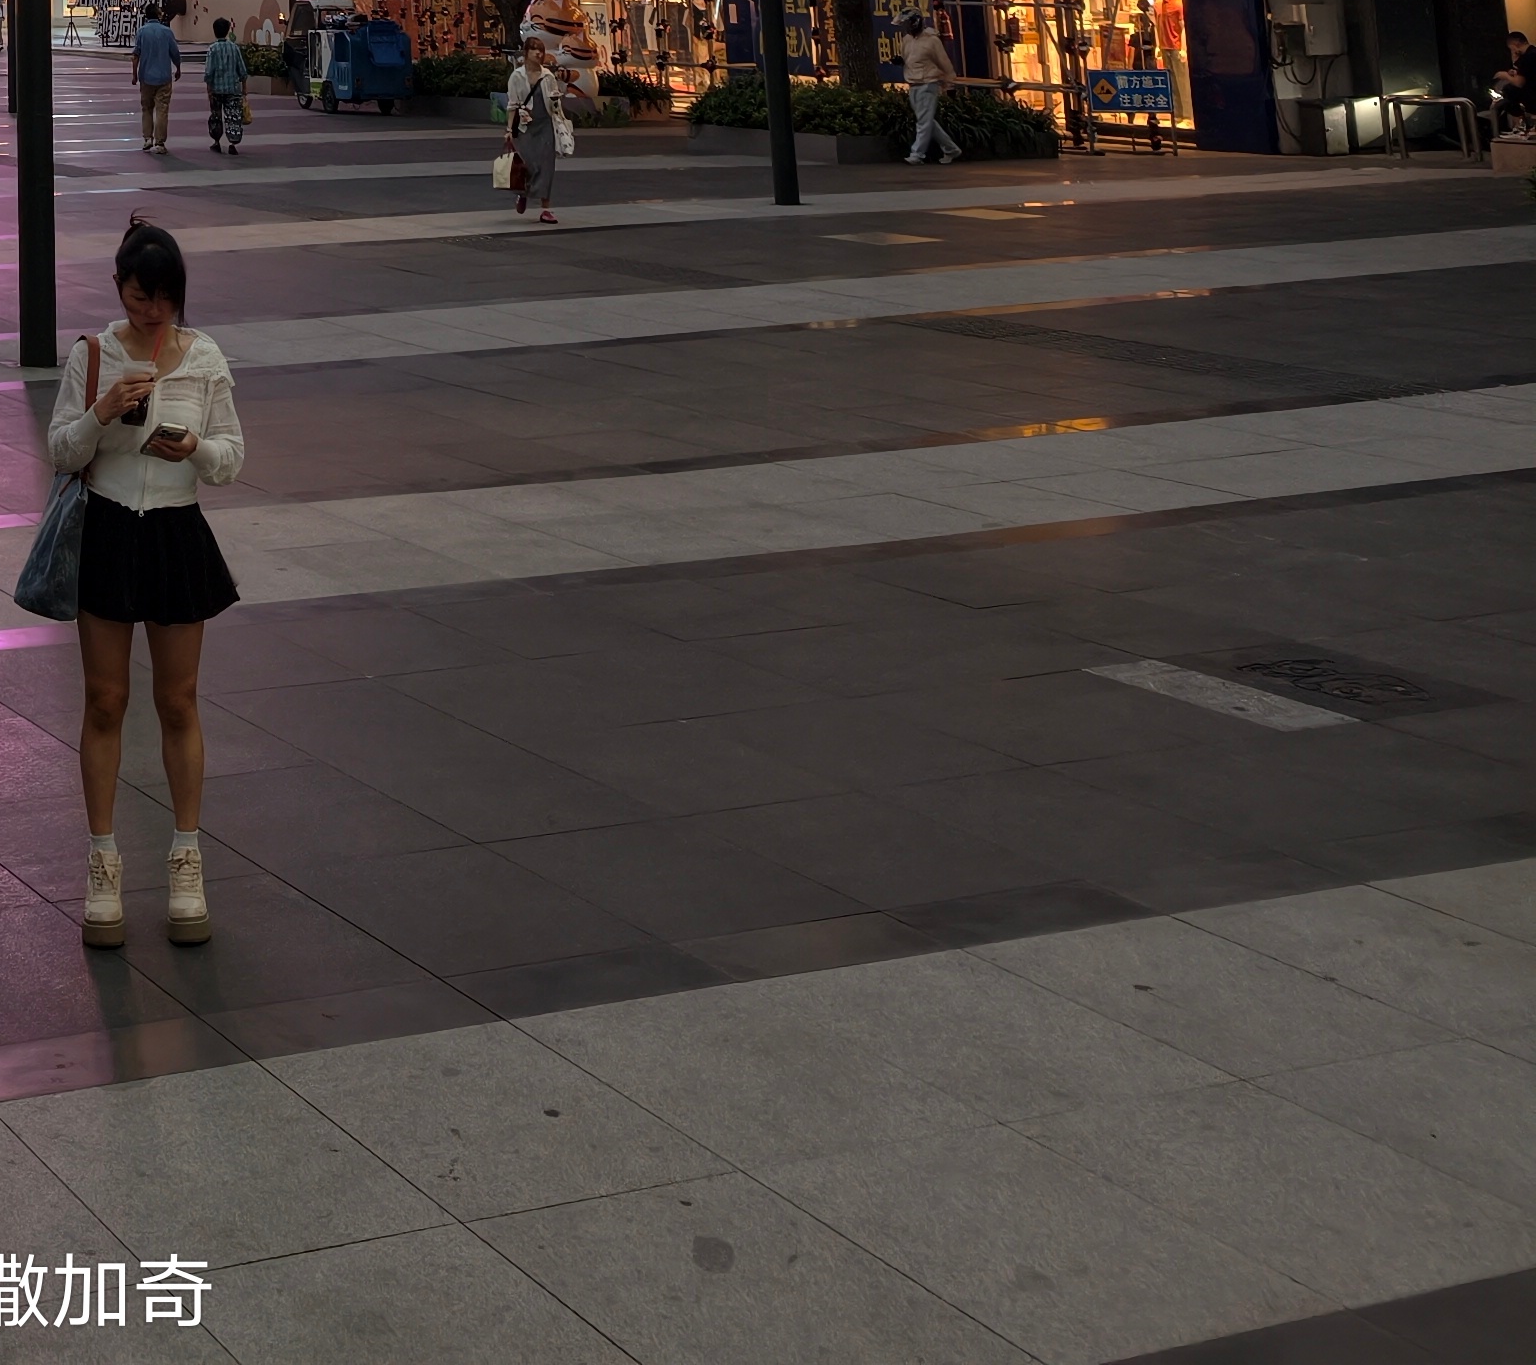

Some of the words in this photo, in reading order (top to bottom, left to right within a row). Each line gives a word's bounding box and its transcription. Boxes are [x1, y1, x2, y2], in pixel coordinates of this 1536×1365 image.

[1116, 75, 1167, 91] 前方施工
[1119, 93, 1169, 109] 注意安全
